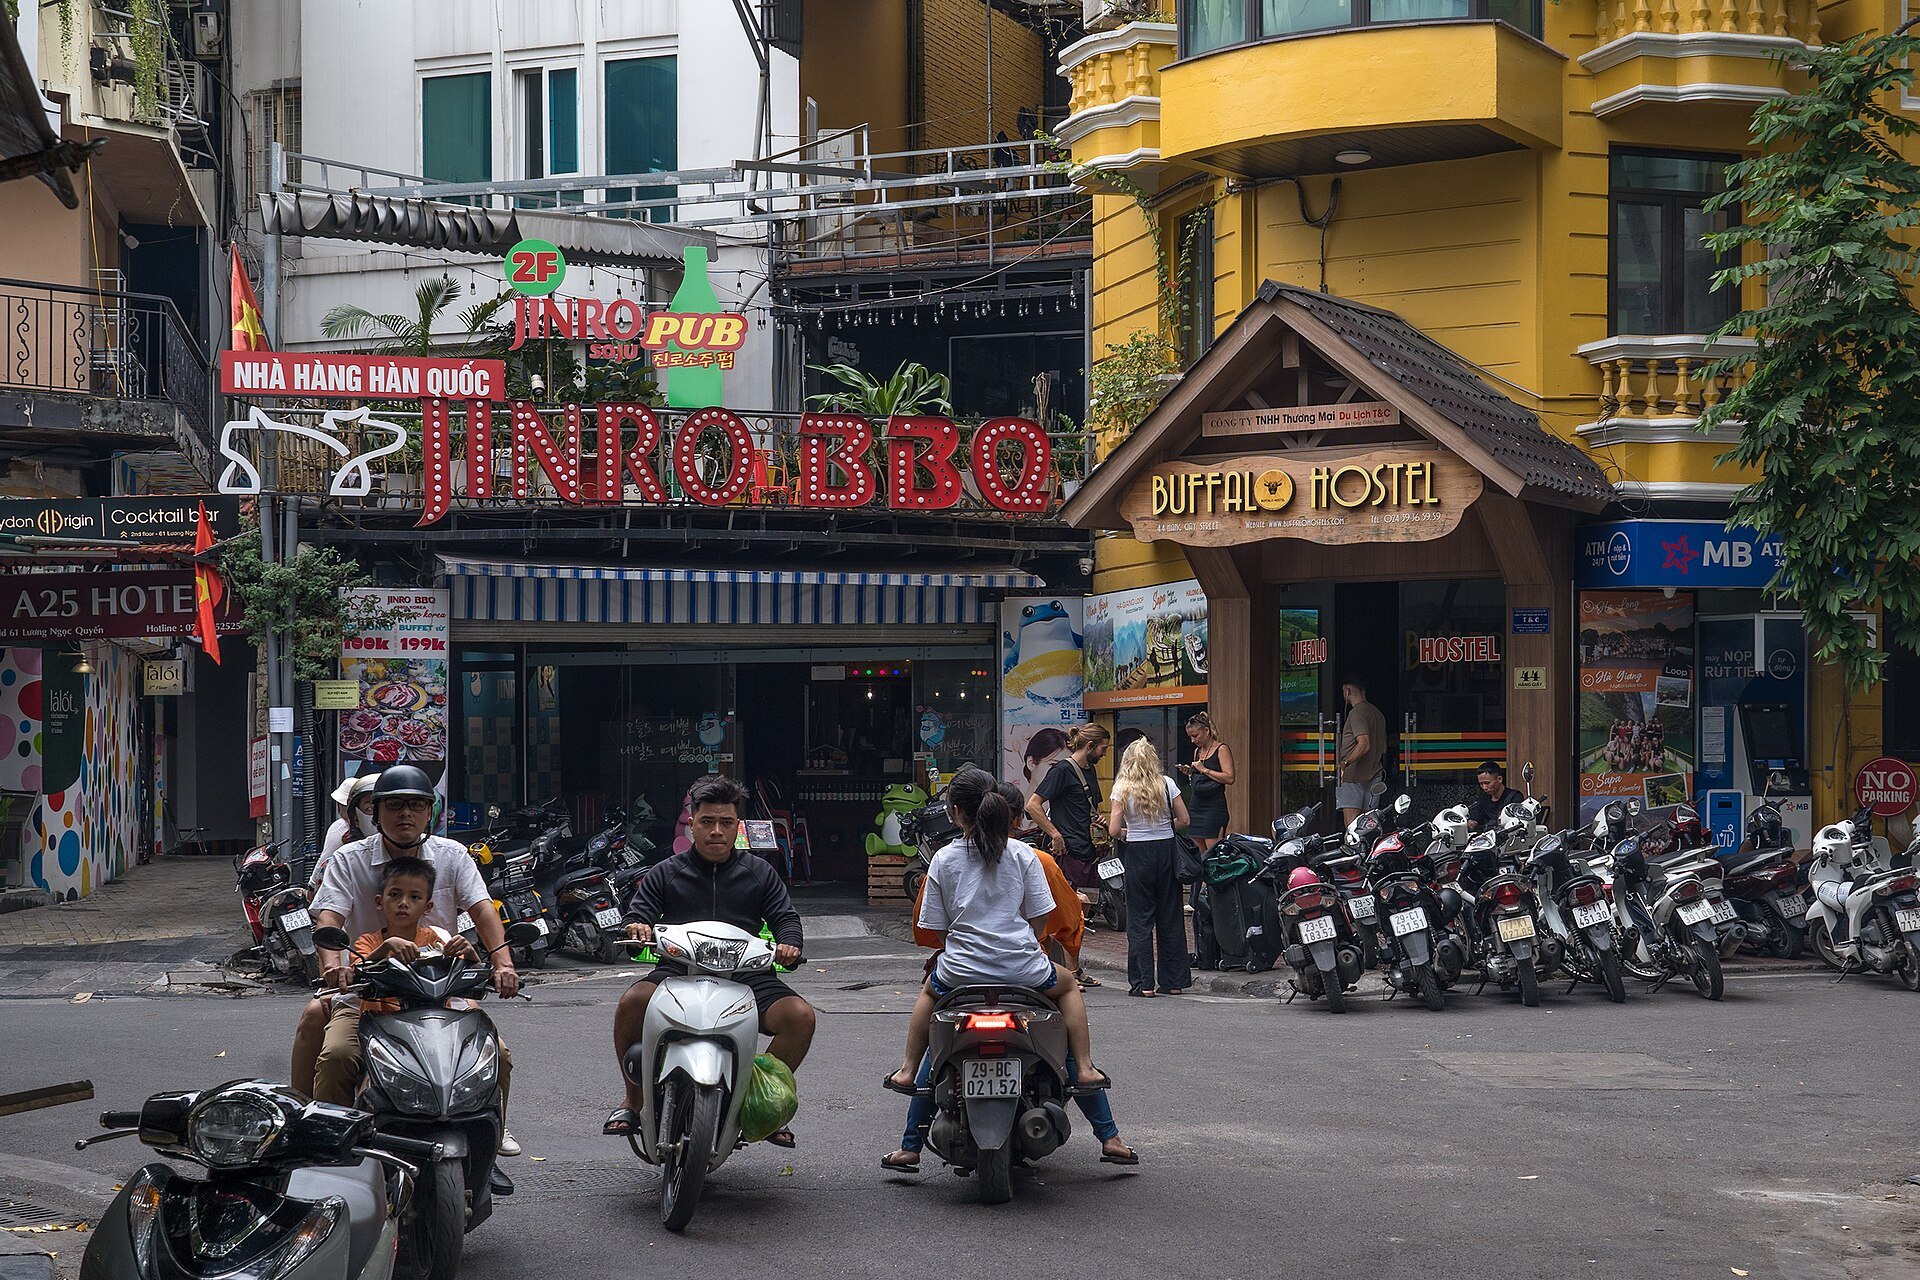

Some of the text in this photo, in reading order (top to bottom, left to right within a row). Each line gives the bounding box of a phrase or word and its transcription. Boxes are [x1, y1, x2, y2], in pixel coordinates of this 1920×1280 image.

[512, 252, 558, 282] 2F
[508, 298, 642, 351] JINRO
[645, 316, 743, 346] PUB
[653, 352, 735, 369] 진로소주 펍
[233, 360, 490, 397] NHÀ HÀNG HÀN QUỐC
[1210, 408, 1391, 428] CÔNG TY TNHH Thương Mại Du Lịch T&C
[415, 399, 1050, 527] JINRO BBQ
[1152, 462, 1439, 515] BUFFALO HOSTEL
[111, 508, 184, 524] Cocktail
[1585, 541, 1605, 556] ATM
[1702, 540, 1753, 568] MB
[12, 584, 199, 618] A25 HOTE
[387, 595, 436, 605] JINRO BBQ
[9, 628, 18, 636] 61
[22, 627, 47, 638] Lương
[49, 626, 72, 638] Ngọc
[146, 623, 177, 632] Hotline
[344, 636, 390, 650] 100k
[400, 637, 446, 651] 199k
[1420, 635, 1500, 663] HOSTEL
[1290, 637, 1327, 666] BUFFALO
[1724, 650, 1753, 664] NỘP
[1521, 670, 1540, 681] 44
[1665, 666, 1688, 677] Loop
[1705, 663, 1732, 678] RÚT
[1596, 771, 1622, 788] Sapa
[1862, 771, 1910, 790] NO
[1862, 790, 1910, 803] PARKING
[1304, 918, 1329, 933] 23-E1
[1395, 919, 1425, 934] 431.51
[1304, 927, 1334, 943] 183.52
[971, 1062, 1012, 1078] 29-BC
[967, 1079, 1018, 1096] 021.52
